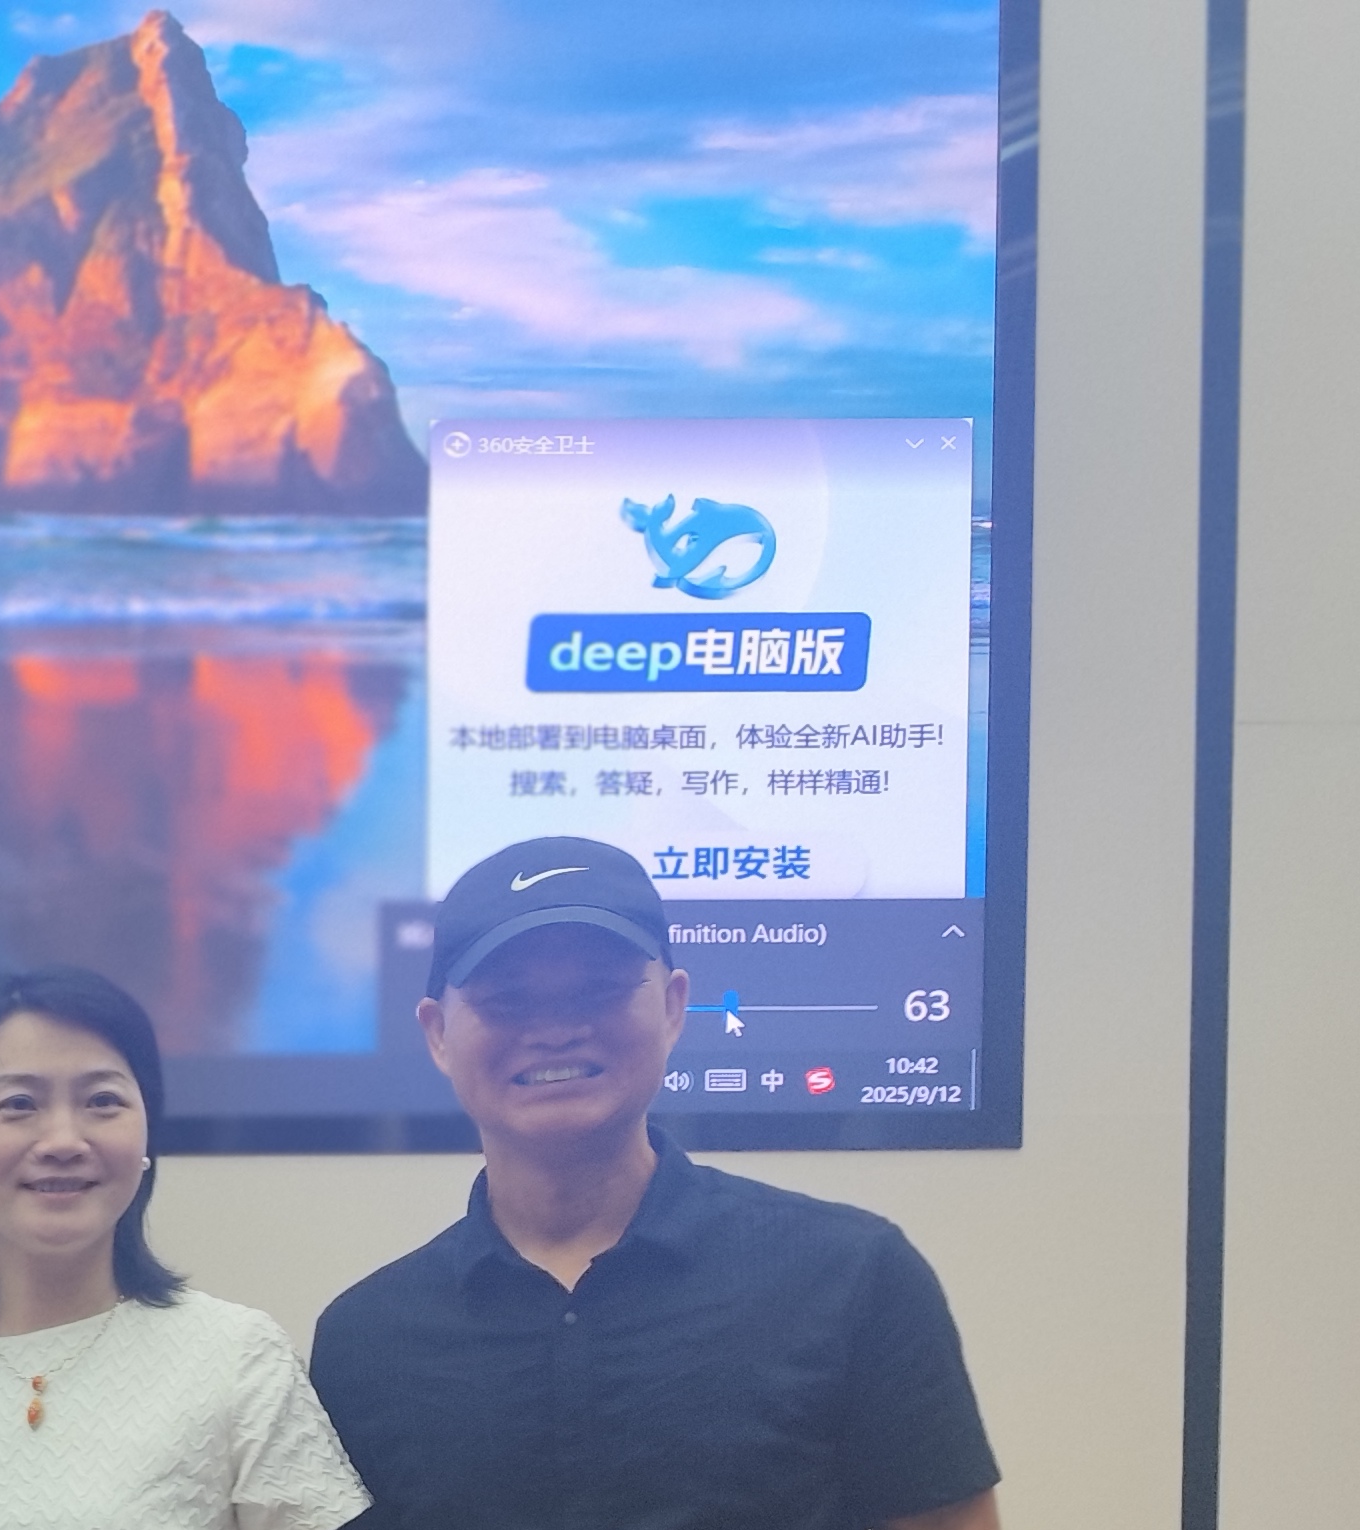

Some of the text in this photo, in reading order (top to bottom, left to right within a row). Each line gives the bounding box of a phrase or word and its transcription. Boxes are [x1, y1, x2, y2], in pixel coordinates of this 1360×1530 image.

[478, 435, 596, 455] 360安全卫士
[549, 628, 846, 682] deep电脑版
[651, 845, 812, 880] 立即安装
[668, 923, 828, 947] finition Audio)
[903, 989, 951, 1023] 63
[885, 1056, 940, 1075] 10:42
[760, 1069, 785, 1093] 中
[860, 1085, 962, 1106] 2025/9/12
